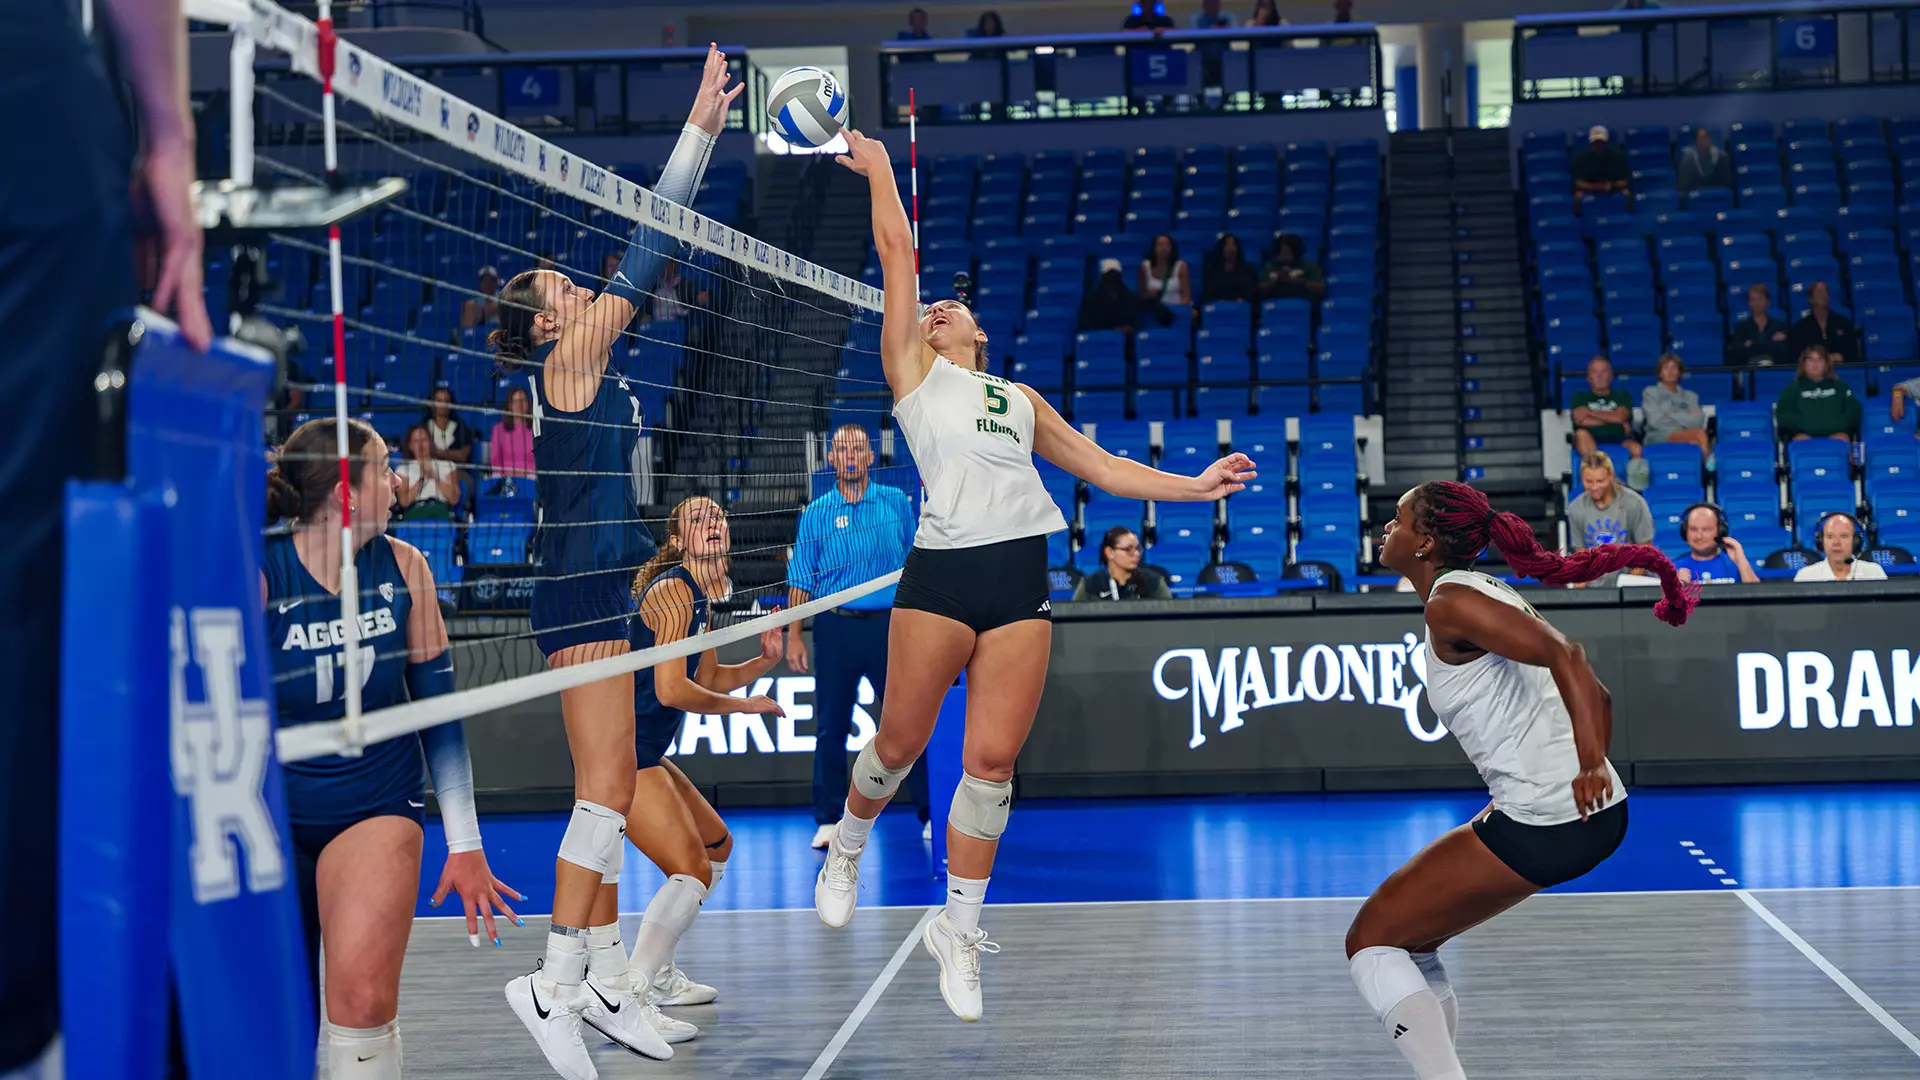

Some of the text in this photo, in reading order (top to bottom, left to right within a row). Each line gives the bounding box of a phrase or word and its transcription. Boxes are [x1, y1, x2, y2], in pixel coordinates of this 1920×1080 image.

[1796, 25, 1816, 50] 6
[1149, 55, 1168, 78] 5
[522, 76, 542, 99] 4
[982, 381, 1011, 418] 5
[170, 605, 287, 905] UK
